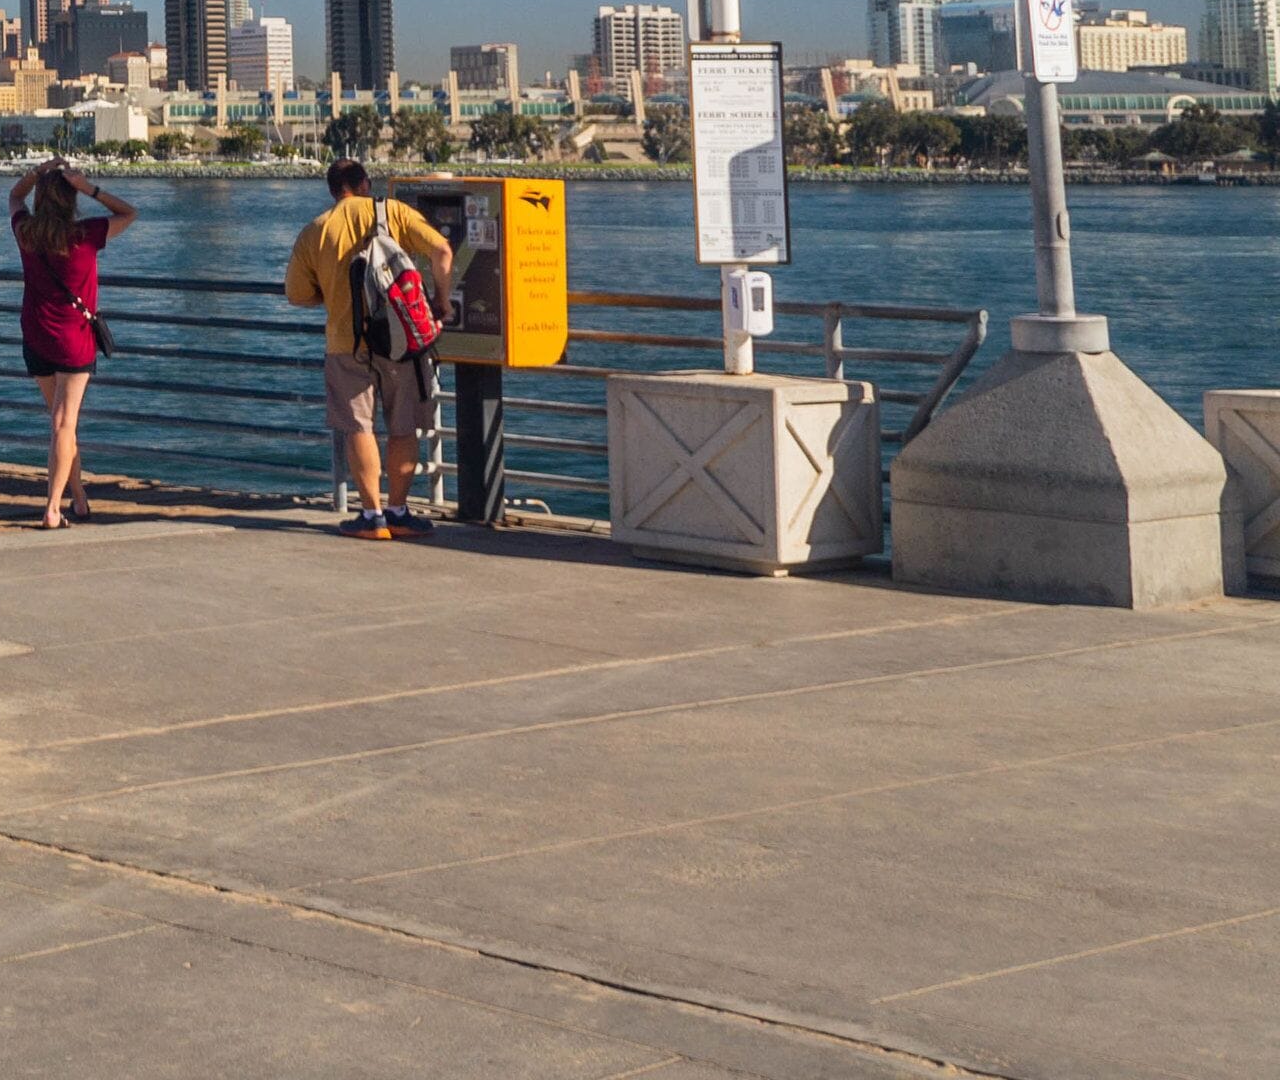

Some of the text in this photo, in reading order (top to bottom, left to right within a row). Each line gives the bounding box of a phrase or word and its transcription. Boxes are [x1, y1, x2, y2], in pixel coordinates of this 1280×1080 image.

[698, 67, 776, 75] FERRY TICKETS
[517, 227, 543, 235] Tickets
[526, 243, 541, 251] also
[519, 259, 559, 269] purchased
